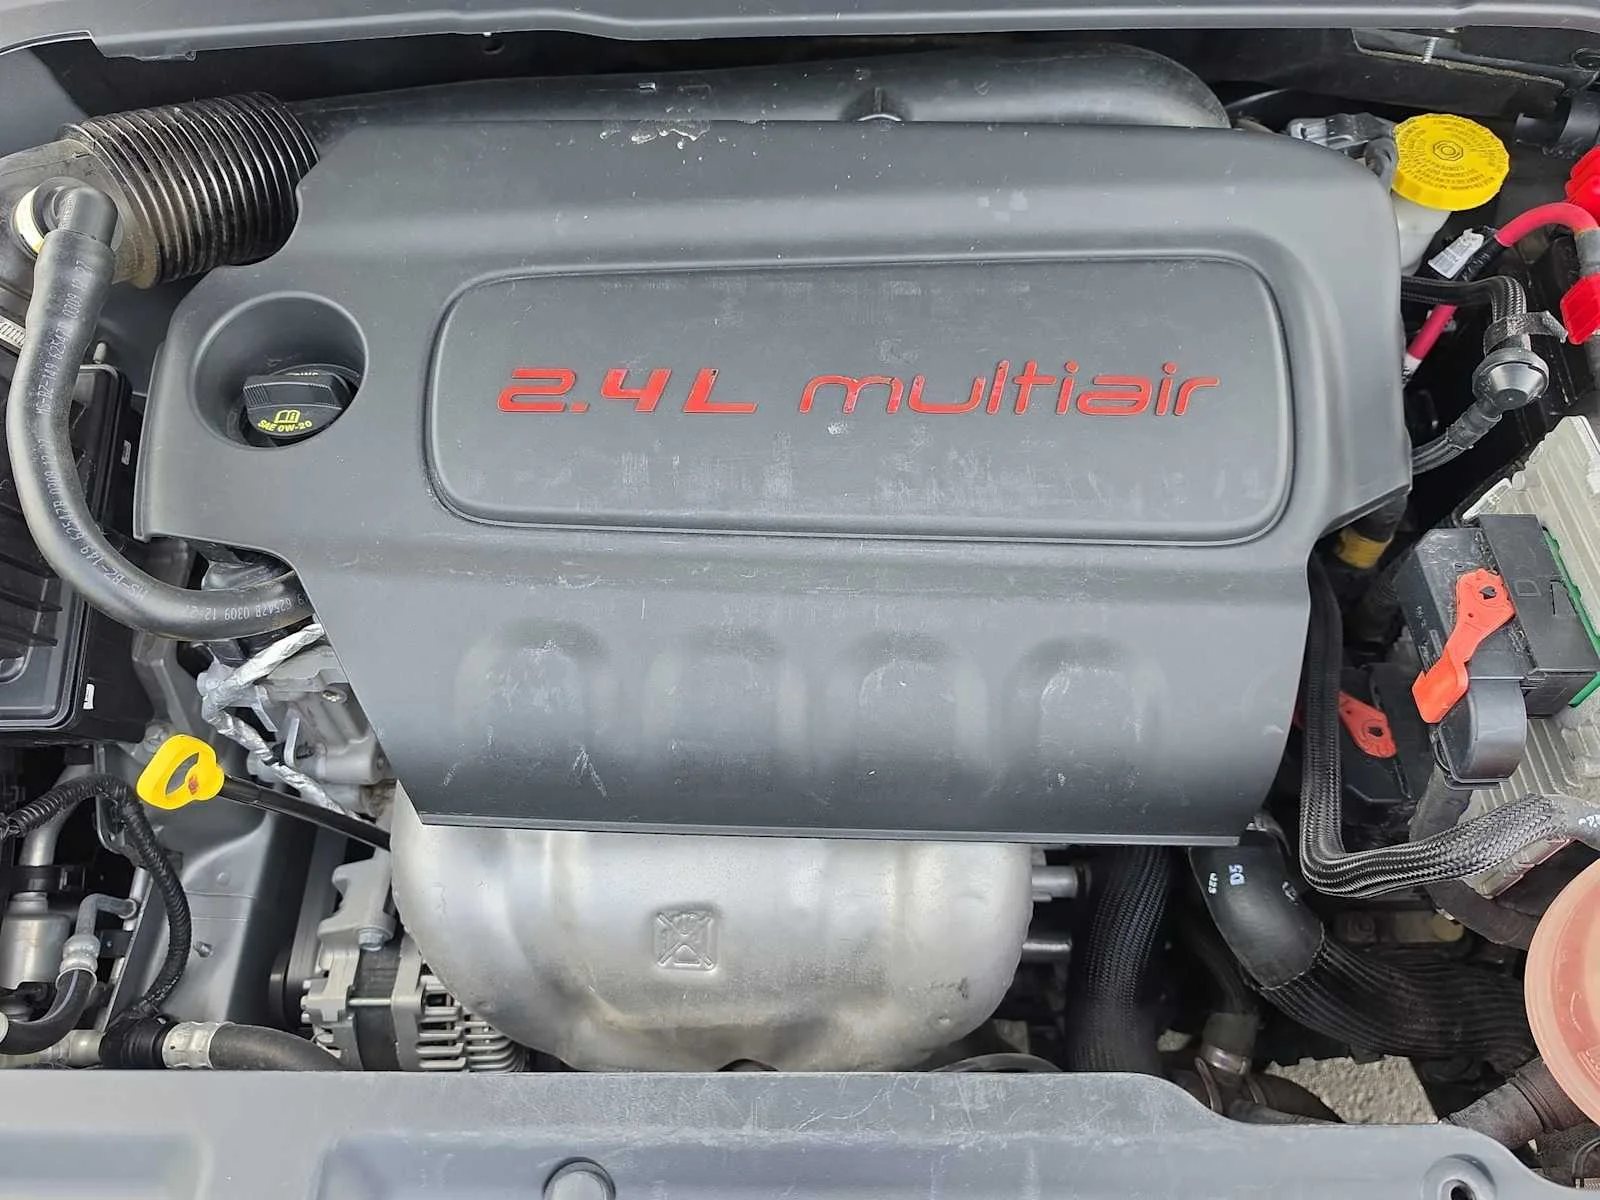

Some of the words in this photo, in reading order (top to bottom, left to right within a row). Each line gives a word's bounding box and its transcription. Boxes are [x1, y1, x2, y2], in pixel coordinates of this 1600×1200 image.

[799, 359, 1220, 415] multiair
[258, 420, 278, 432] SAE
[277, 420, 313, 432] 0W-20
[1228, 864, 1245, 886] D5
